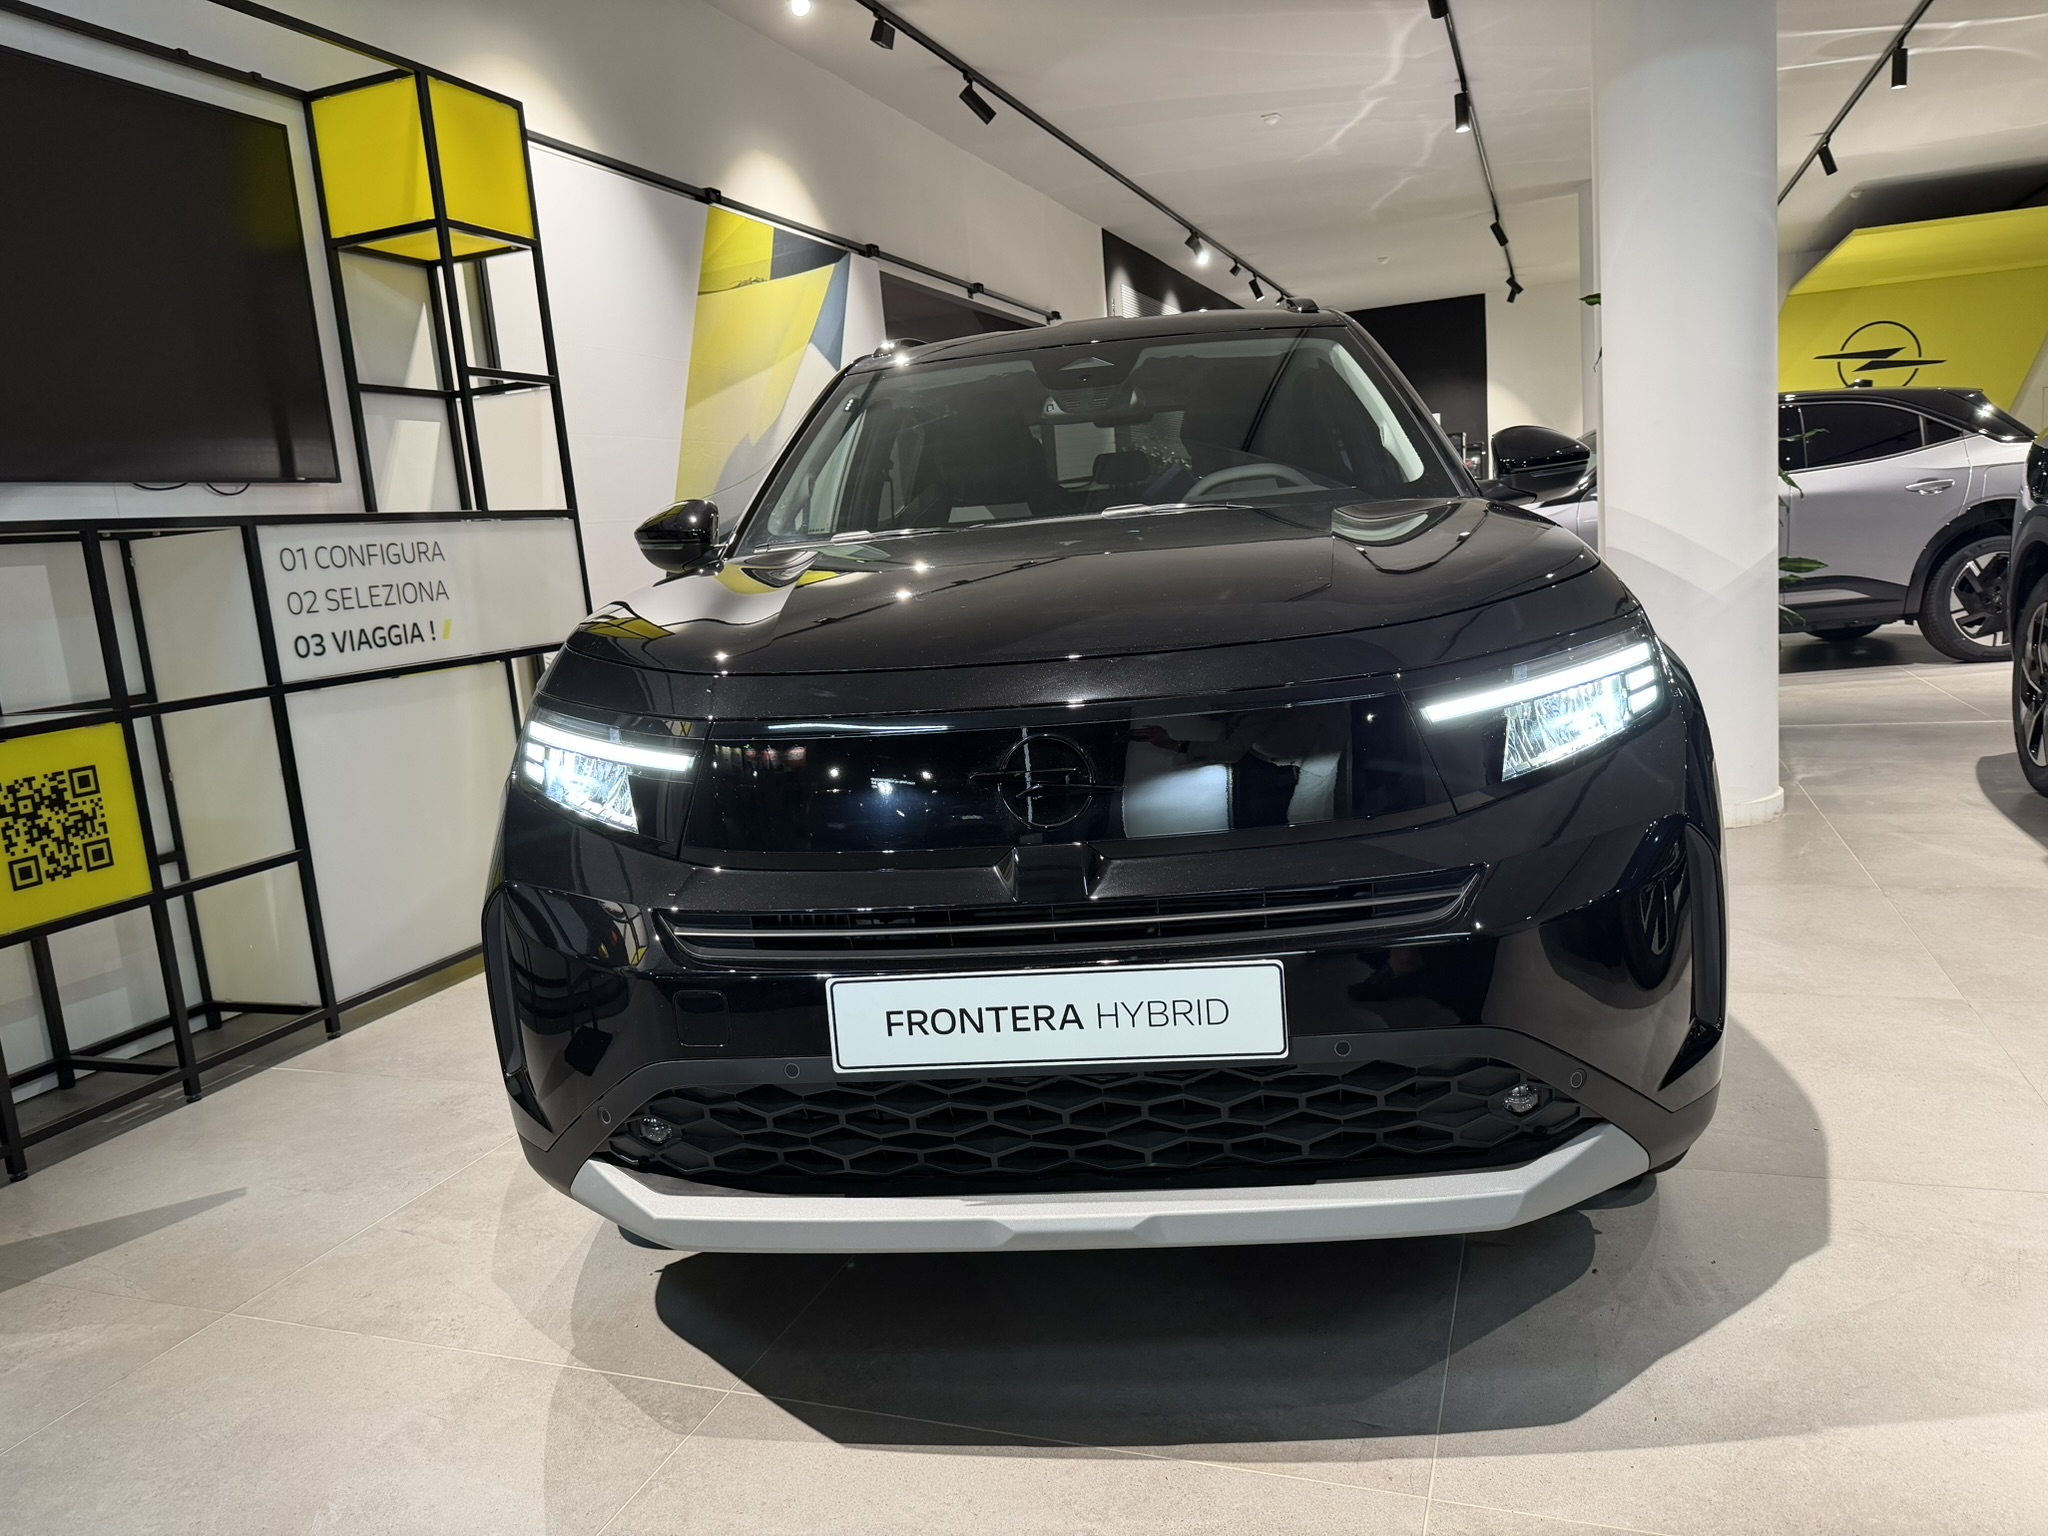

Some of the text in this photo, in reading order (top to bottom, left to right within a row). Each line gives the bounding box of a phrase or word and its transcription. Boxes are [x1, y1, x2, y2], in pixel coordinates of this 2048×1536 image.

[279, 541, 446, 572] 01 CONFIGURA
[286, 580, 450, 616] 02 SELEZIONA
[294, 633, 327, 658] 03
[331, 622, 425, 653] VIAGGIA
[885, 998, 1230, 1037] FRONTERA HYBRID
